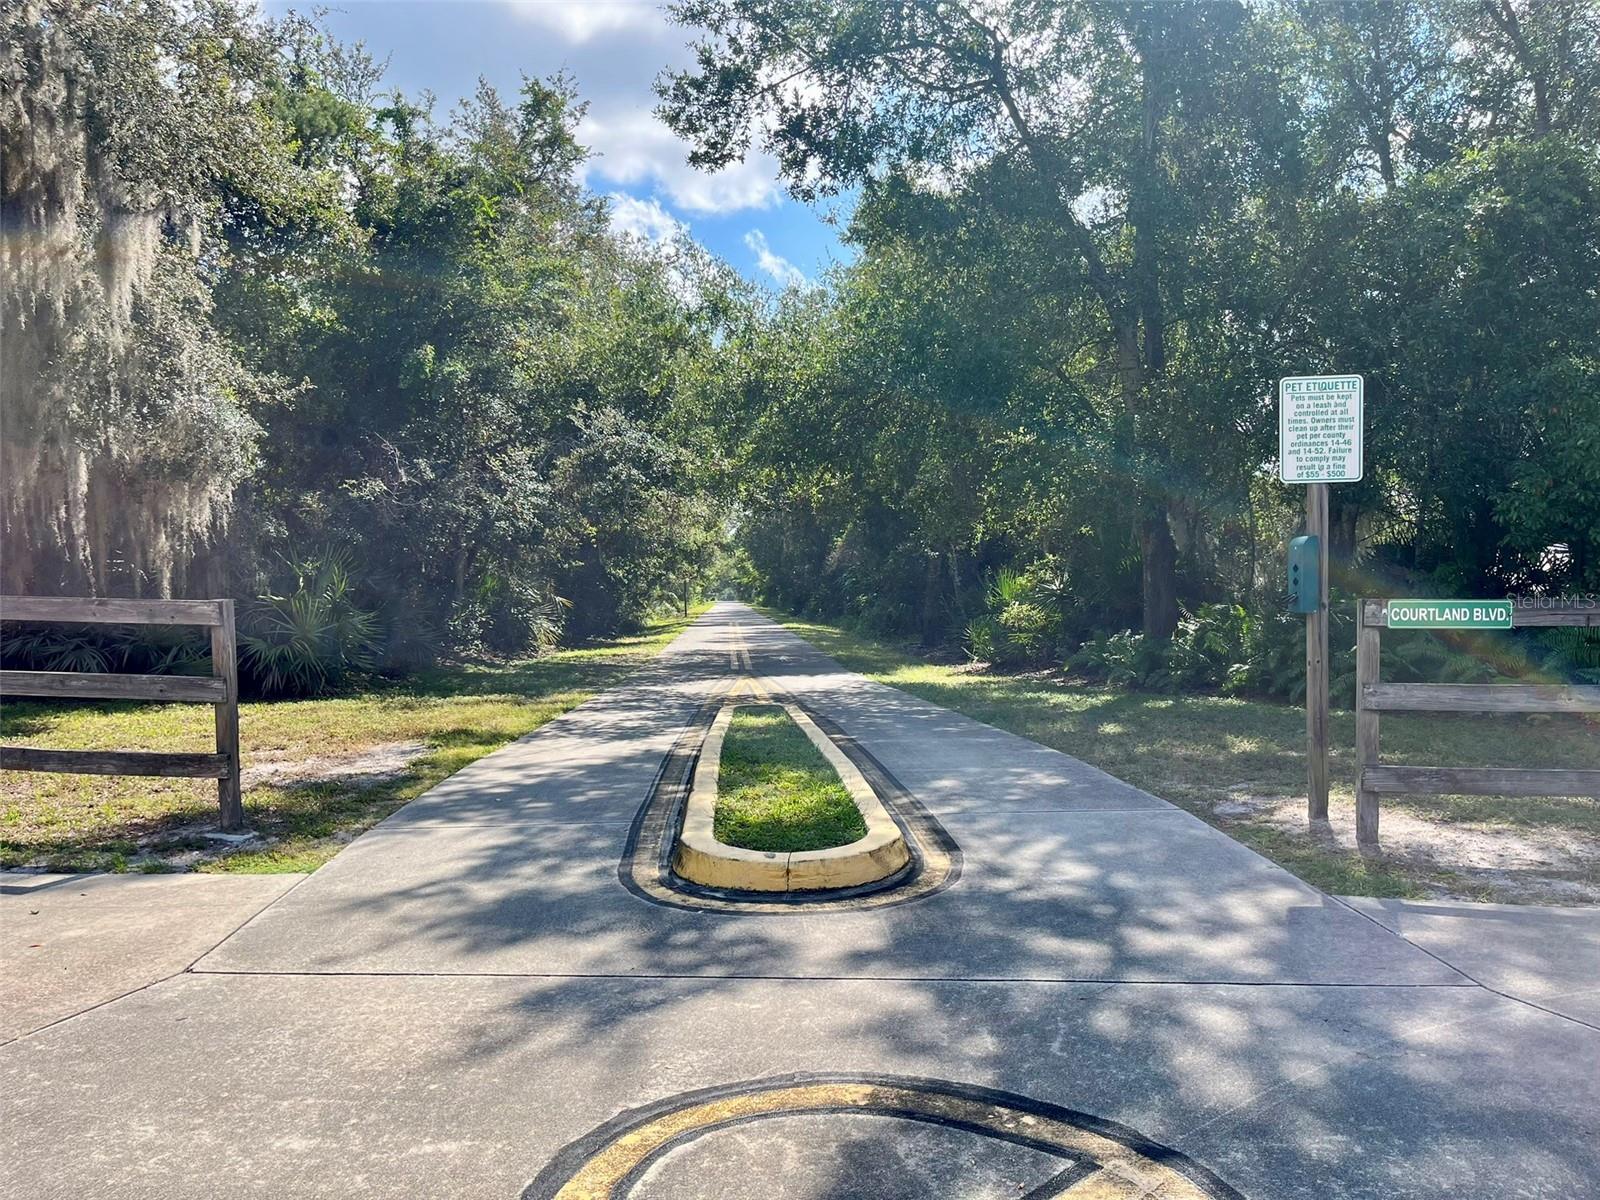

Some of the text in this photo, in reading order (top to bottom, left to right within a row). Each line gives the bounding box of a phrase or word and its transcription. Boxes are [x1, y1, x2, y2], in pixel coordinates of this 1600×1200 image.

[1286, 381, 1357, 392] PET ETIQUETTE
[1391, 607, 1469, 621] COURTLAND
